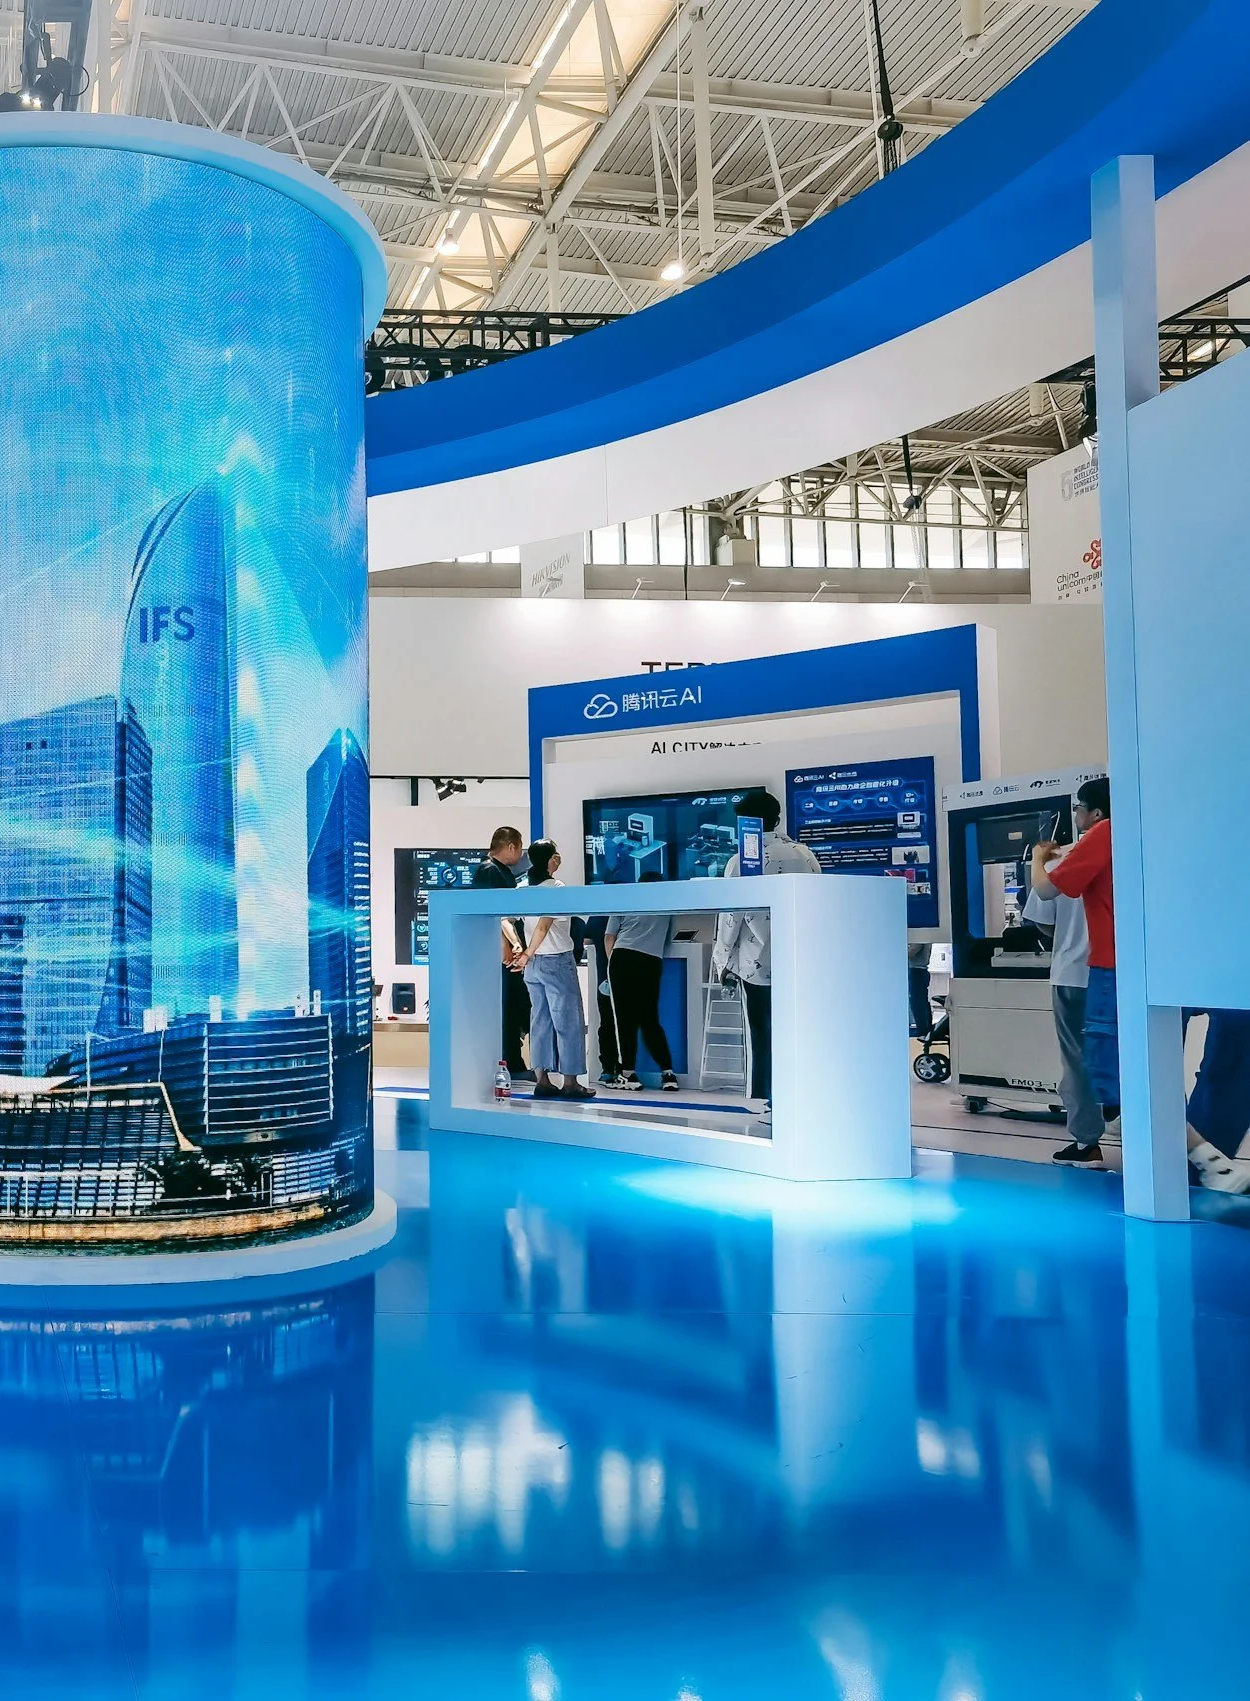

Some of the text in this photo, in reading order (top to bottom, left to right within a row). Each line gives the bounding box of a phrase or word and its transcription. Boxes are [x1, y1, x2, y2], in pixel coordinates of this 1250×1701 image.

[531, 552, 571, 587] HIKVISION
[1056, 571, 1079, 584] China
[1057, 577, 1086, 592] unicom
[139, 605, 195, 643] IFS
[622, 685, 702, 713] 腾讯云AI
[651, 741, 666, 754] AI
